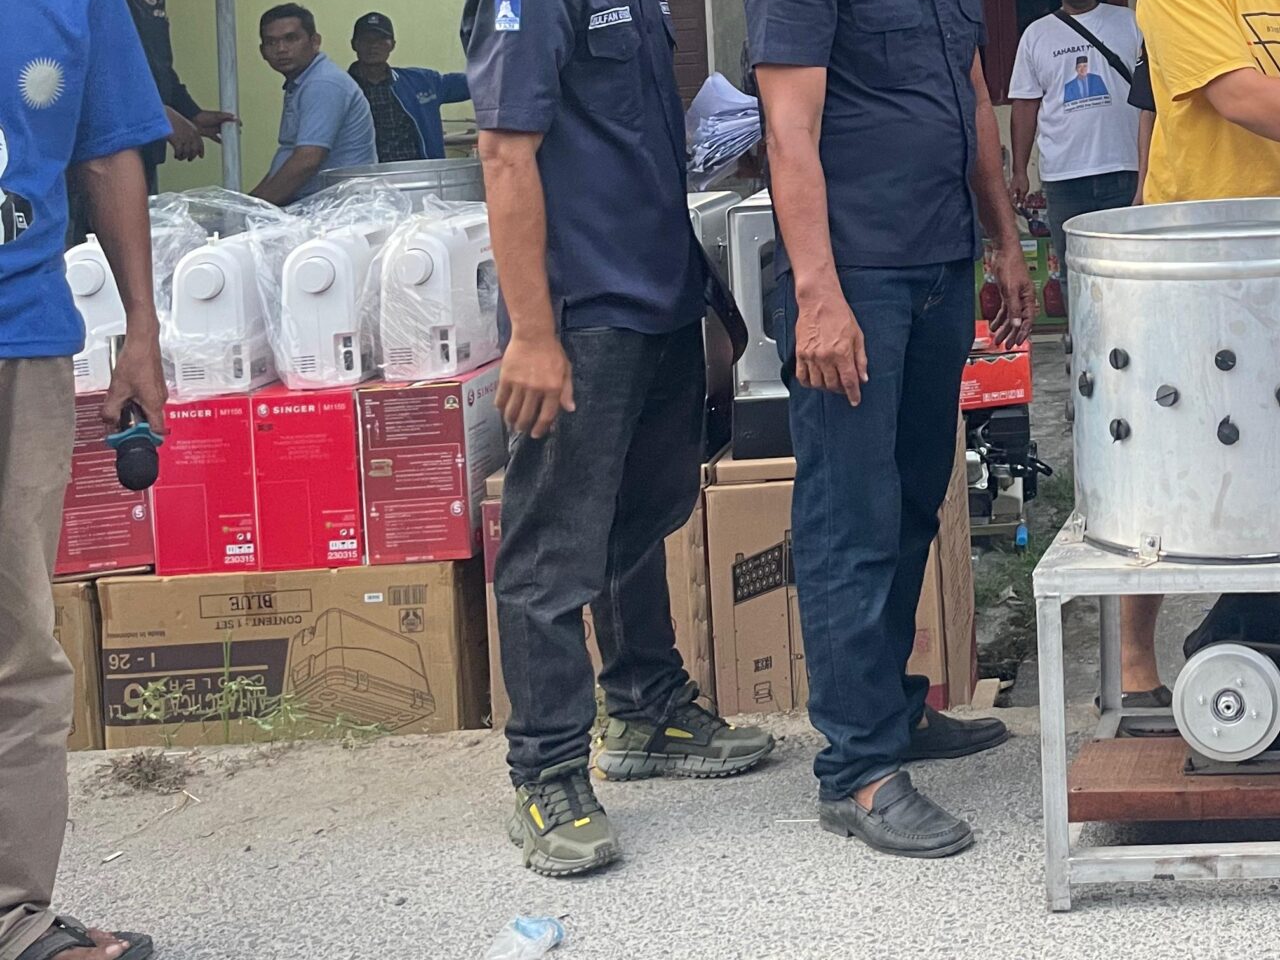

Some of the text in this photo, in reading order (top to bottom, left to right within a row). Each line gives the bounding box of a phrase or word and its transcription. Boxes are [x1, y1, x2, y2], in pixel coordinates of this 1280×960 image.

[169, 409, 212, 419] SINGER
[273, 405, 315, 414] SINGER
[224, 555, 255, 564] 230315
[327, 551, 358, 560] 230315
[229, 593, 274, 611] BLUE
[214, 619, 234, 630] SET
[108, 653, 131, 670] 26
